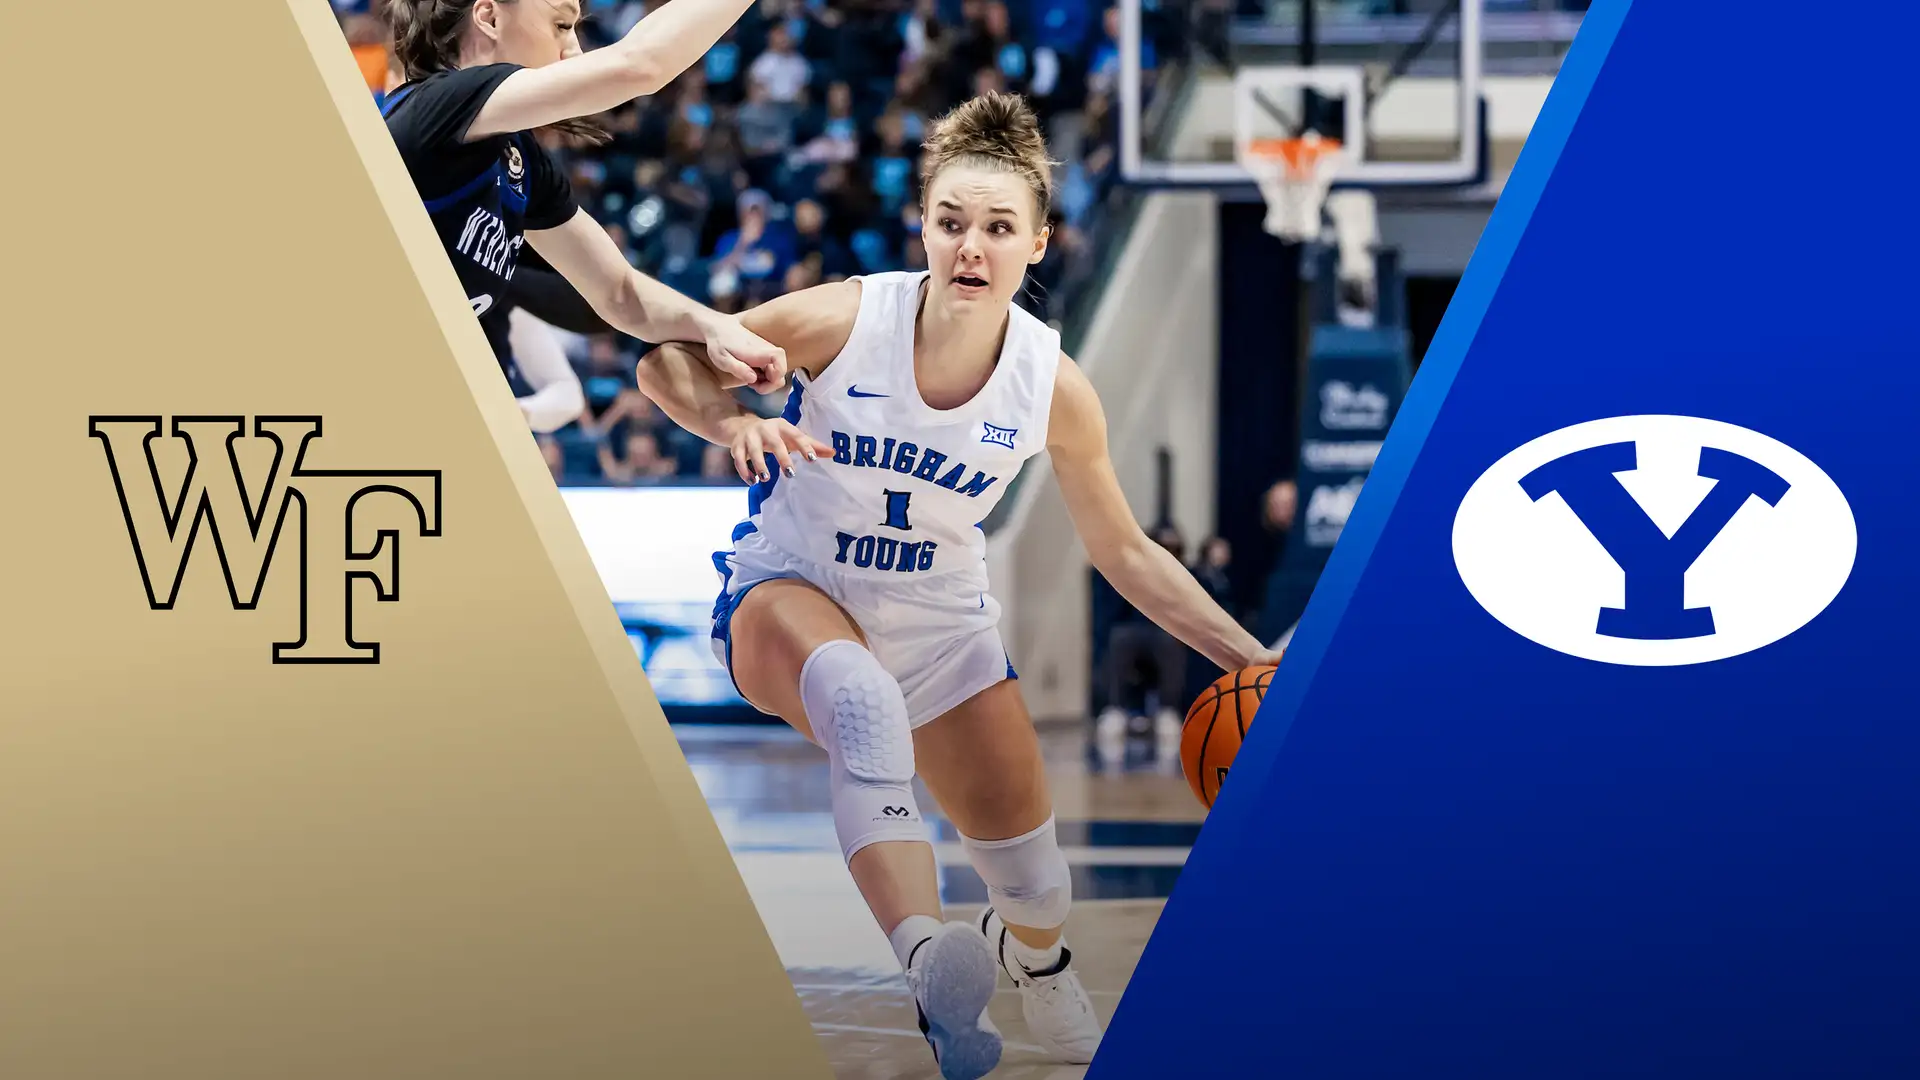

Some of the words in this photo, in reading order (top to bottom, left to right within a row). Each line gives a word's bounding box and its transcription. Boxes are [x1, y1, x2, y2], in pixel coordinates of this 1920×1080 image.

[981, 421, 1019, 450] XII
[831, 430, 998, 498] BRIGHAM
[878, 488, 912, 530] 1
[835, 531, 938, 573] YOUNG
